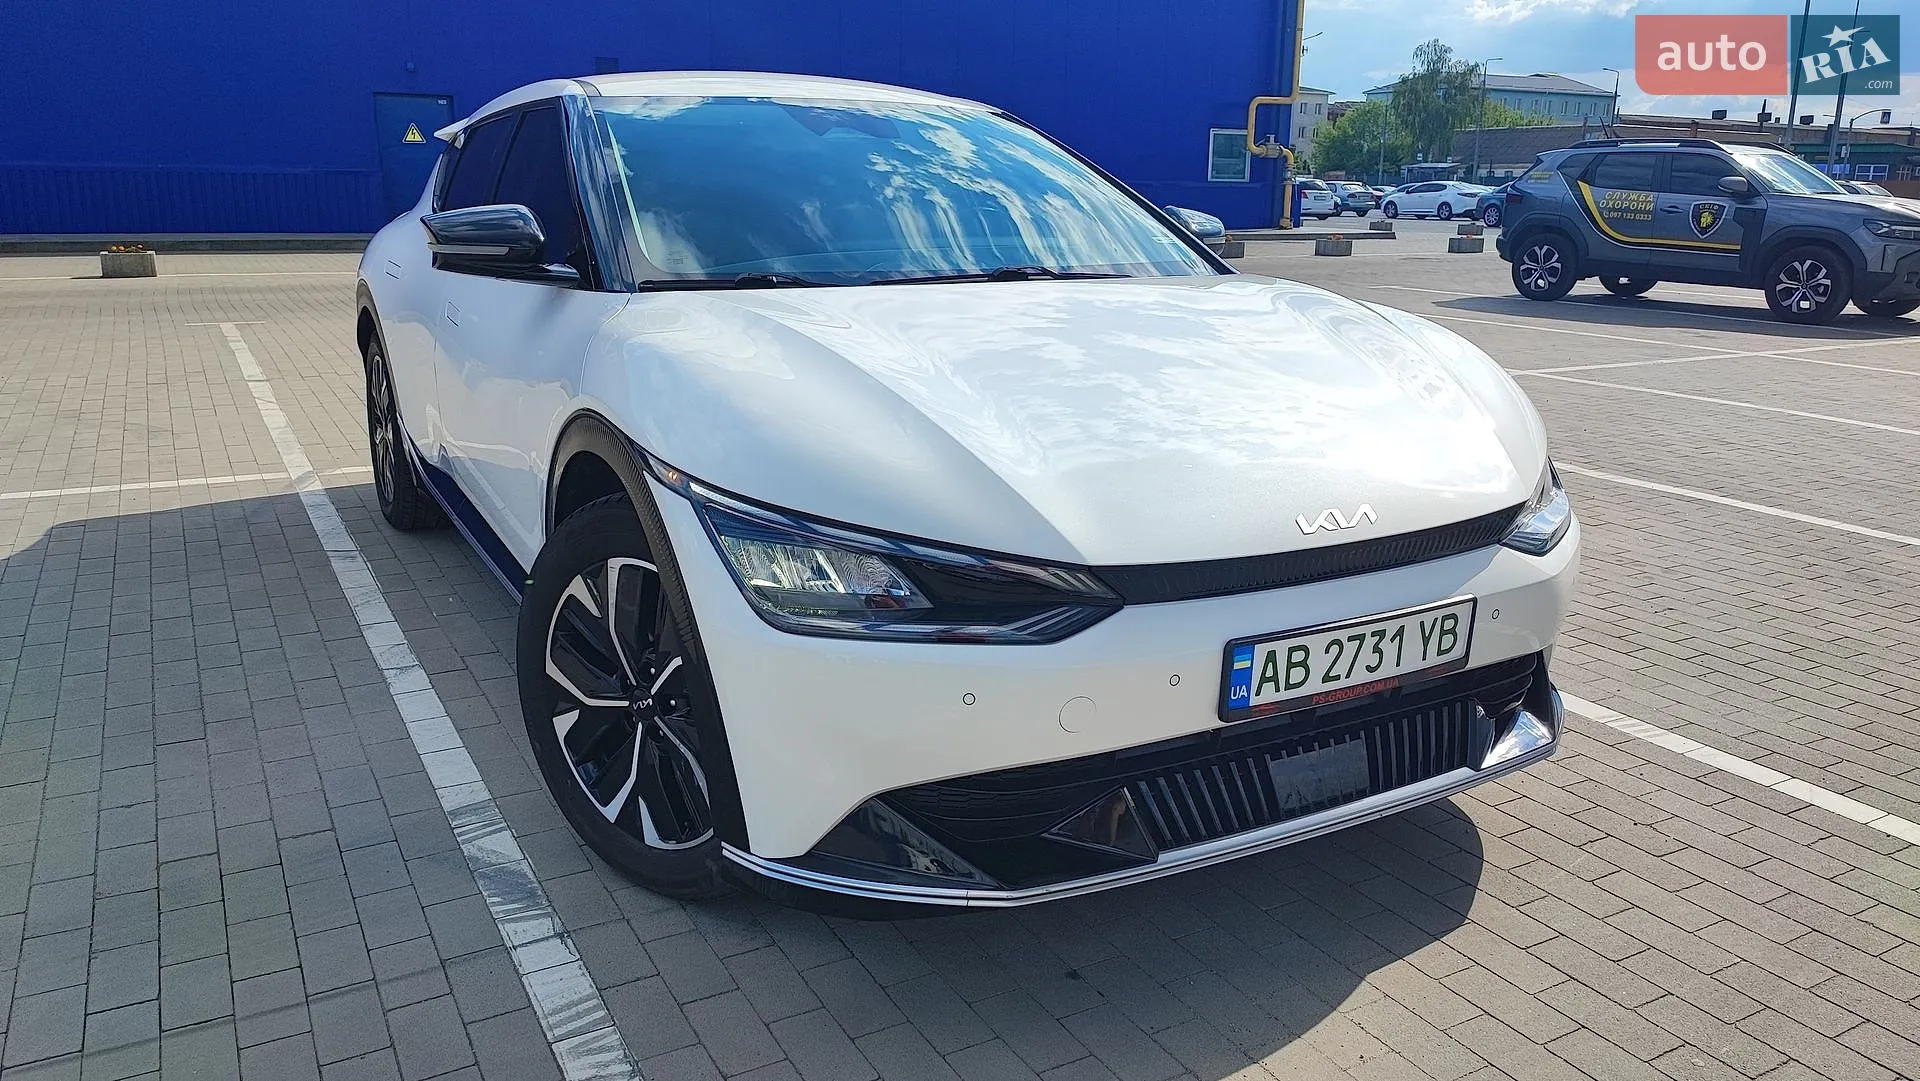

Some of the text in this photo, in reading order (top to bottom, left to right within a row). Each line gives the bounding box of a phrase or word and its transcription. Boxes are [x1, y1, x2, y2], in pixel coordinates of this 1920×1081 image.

[1605, 191, 1654, 202] СЛУЖБА
[1599, 200, 1655, 211] ОХОРОНИ
[1295, 503, 1378, 535] KIA
[1255, 613, 1459, 696] AB 2731 YB
[1230, 684, 1248, 700] UA
